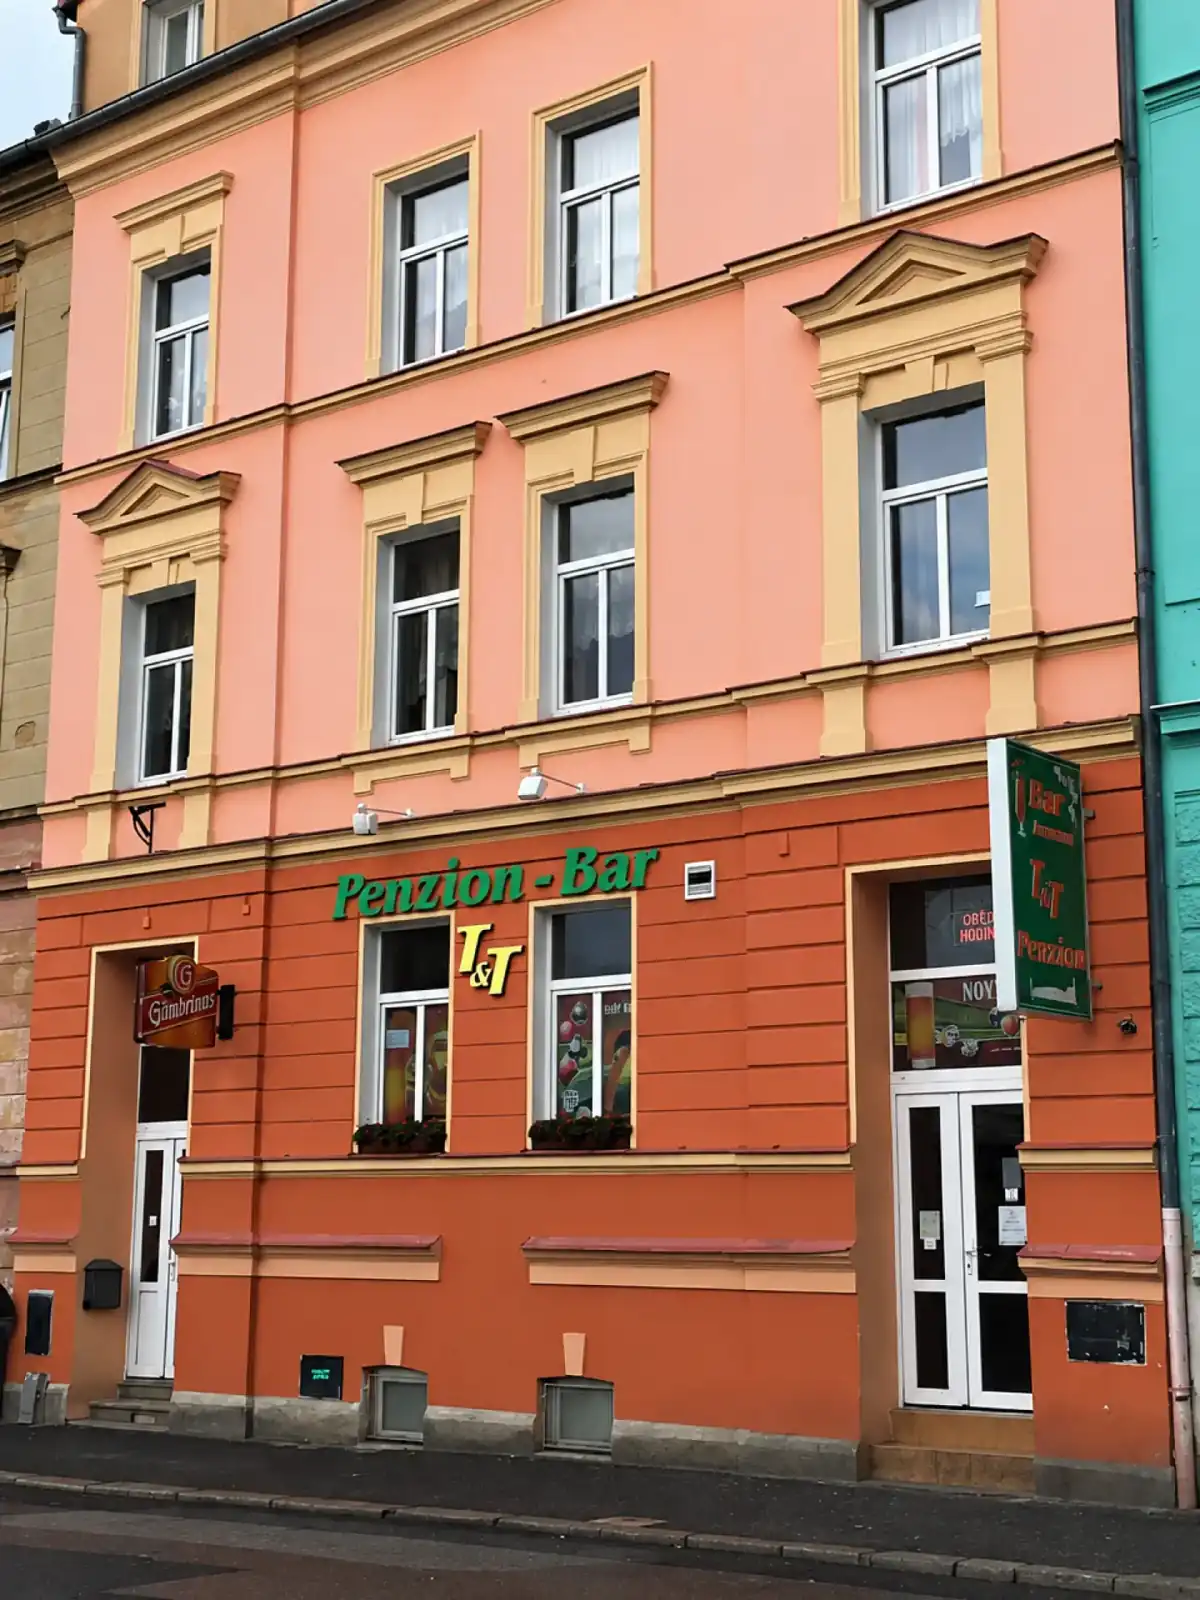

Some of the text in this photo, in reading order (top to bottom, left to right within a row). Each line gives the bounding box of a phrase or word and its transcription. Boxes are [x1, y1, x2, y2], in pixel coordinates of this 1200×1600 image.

[1028, 778, 1067, 817] Bar
[332, 846, 660, 920] Penzion - Bar
[1017, 930, 1085, 970] Penzion
